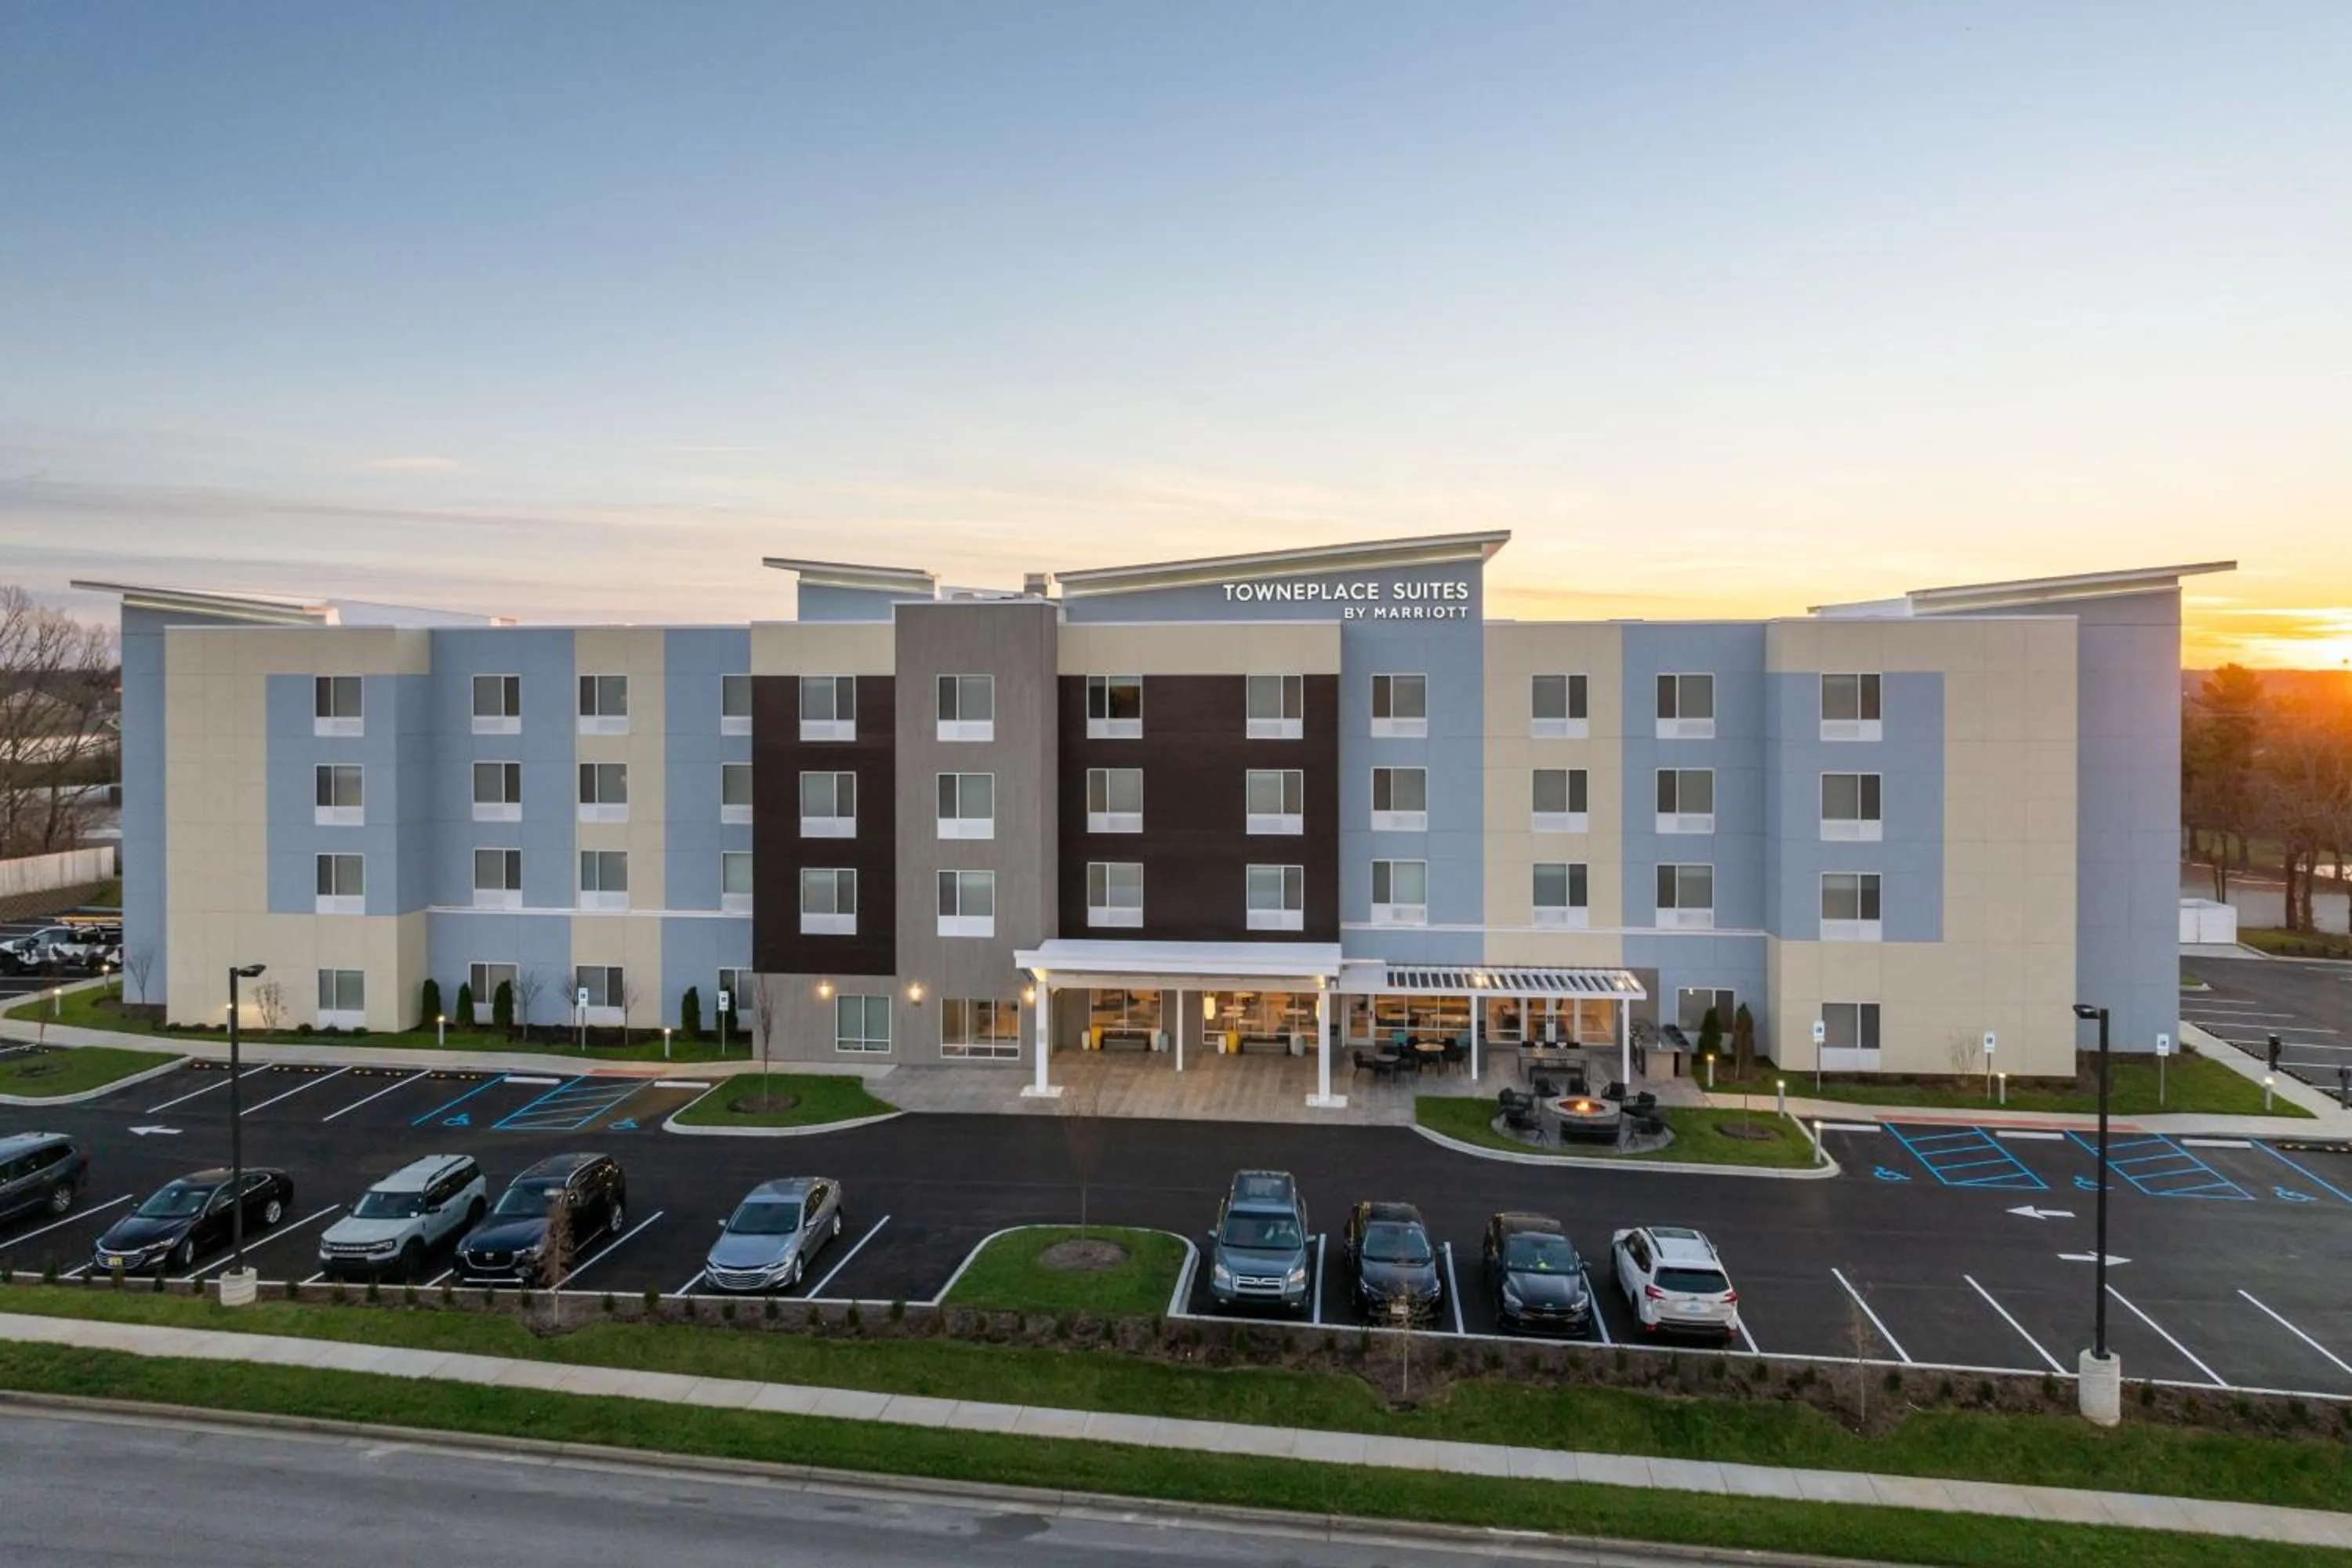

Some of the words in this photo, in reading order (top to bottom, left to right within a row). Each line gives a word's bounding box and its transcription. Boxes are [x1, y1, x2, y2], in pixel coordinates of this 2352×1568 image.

[1223, 583, 1379, 601] TOWNEPLACE
[1392, 583, 1469, 600] SUITES
[1344, 607, 1364, 619] BY
[1374, 606, 1468, 619] MARRIOTT
